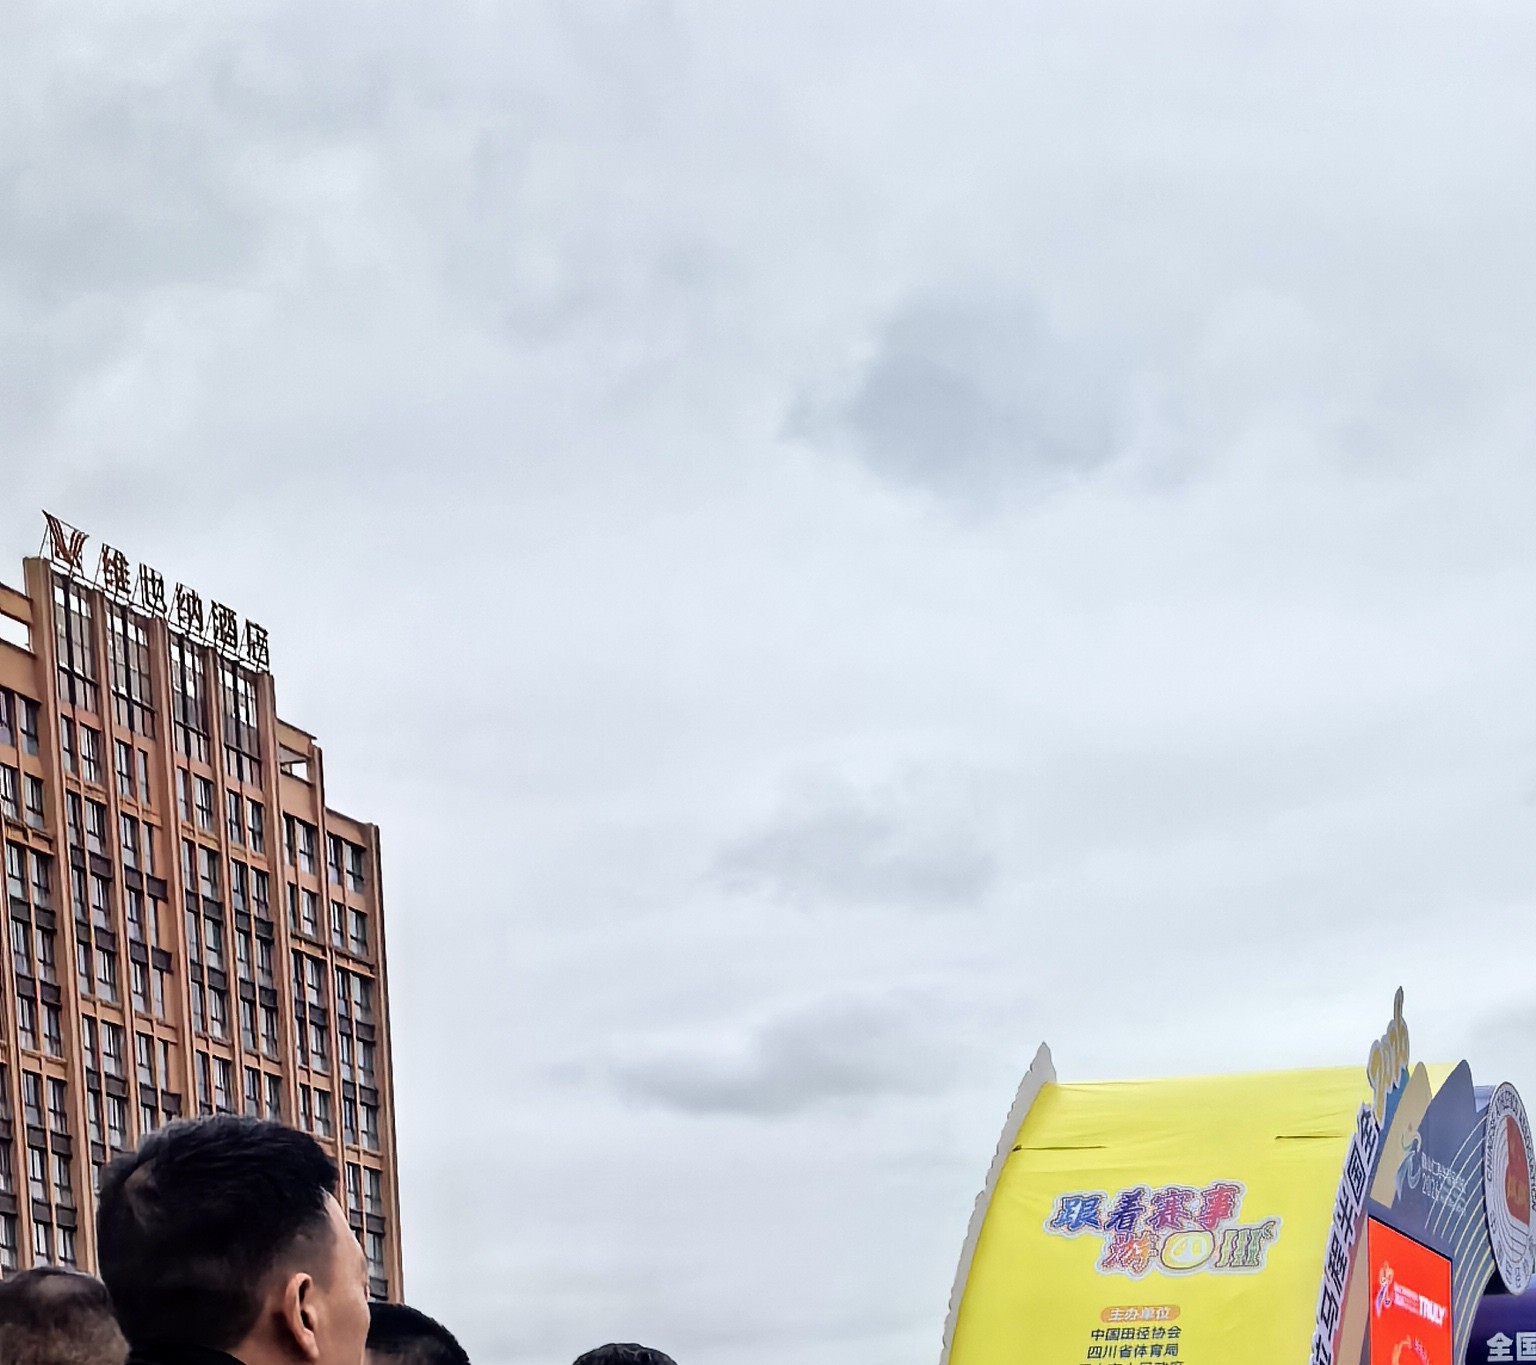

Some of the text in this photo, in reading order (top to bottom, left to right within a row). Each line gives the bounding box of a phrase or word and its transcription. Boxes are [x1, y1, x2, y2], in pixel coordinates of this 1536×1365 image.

[1051, 1183, 1242, 1233] 跟着赛事
[1091, 1326, 1182, 1341] 中国田径协会
[1087, 1344, 1179, 1359] 四川省体育局
